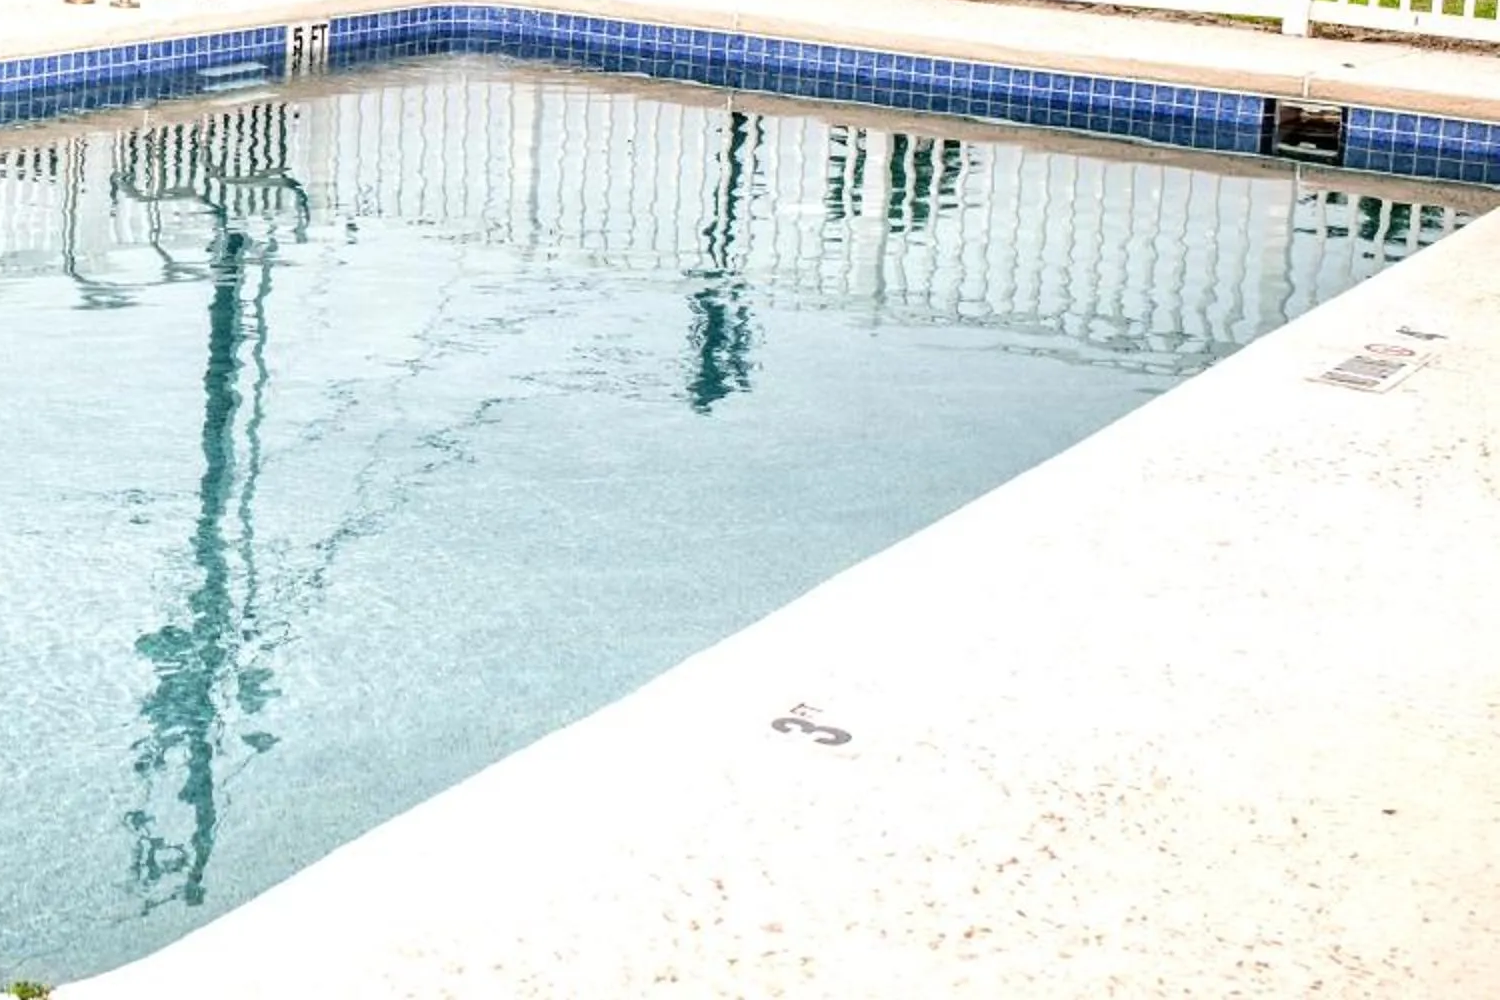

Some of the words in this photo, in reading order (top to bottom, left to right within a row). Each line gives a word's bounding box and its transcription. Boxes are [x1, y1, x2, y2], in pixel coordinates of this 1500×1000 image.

[293, 26, 303, 57] 5
[311, 24, 328, 56] FT
[771, 717, 852, 746] 3
